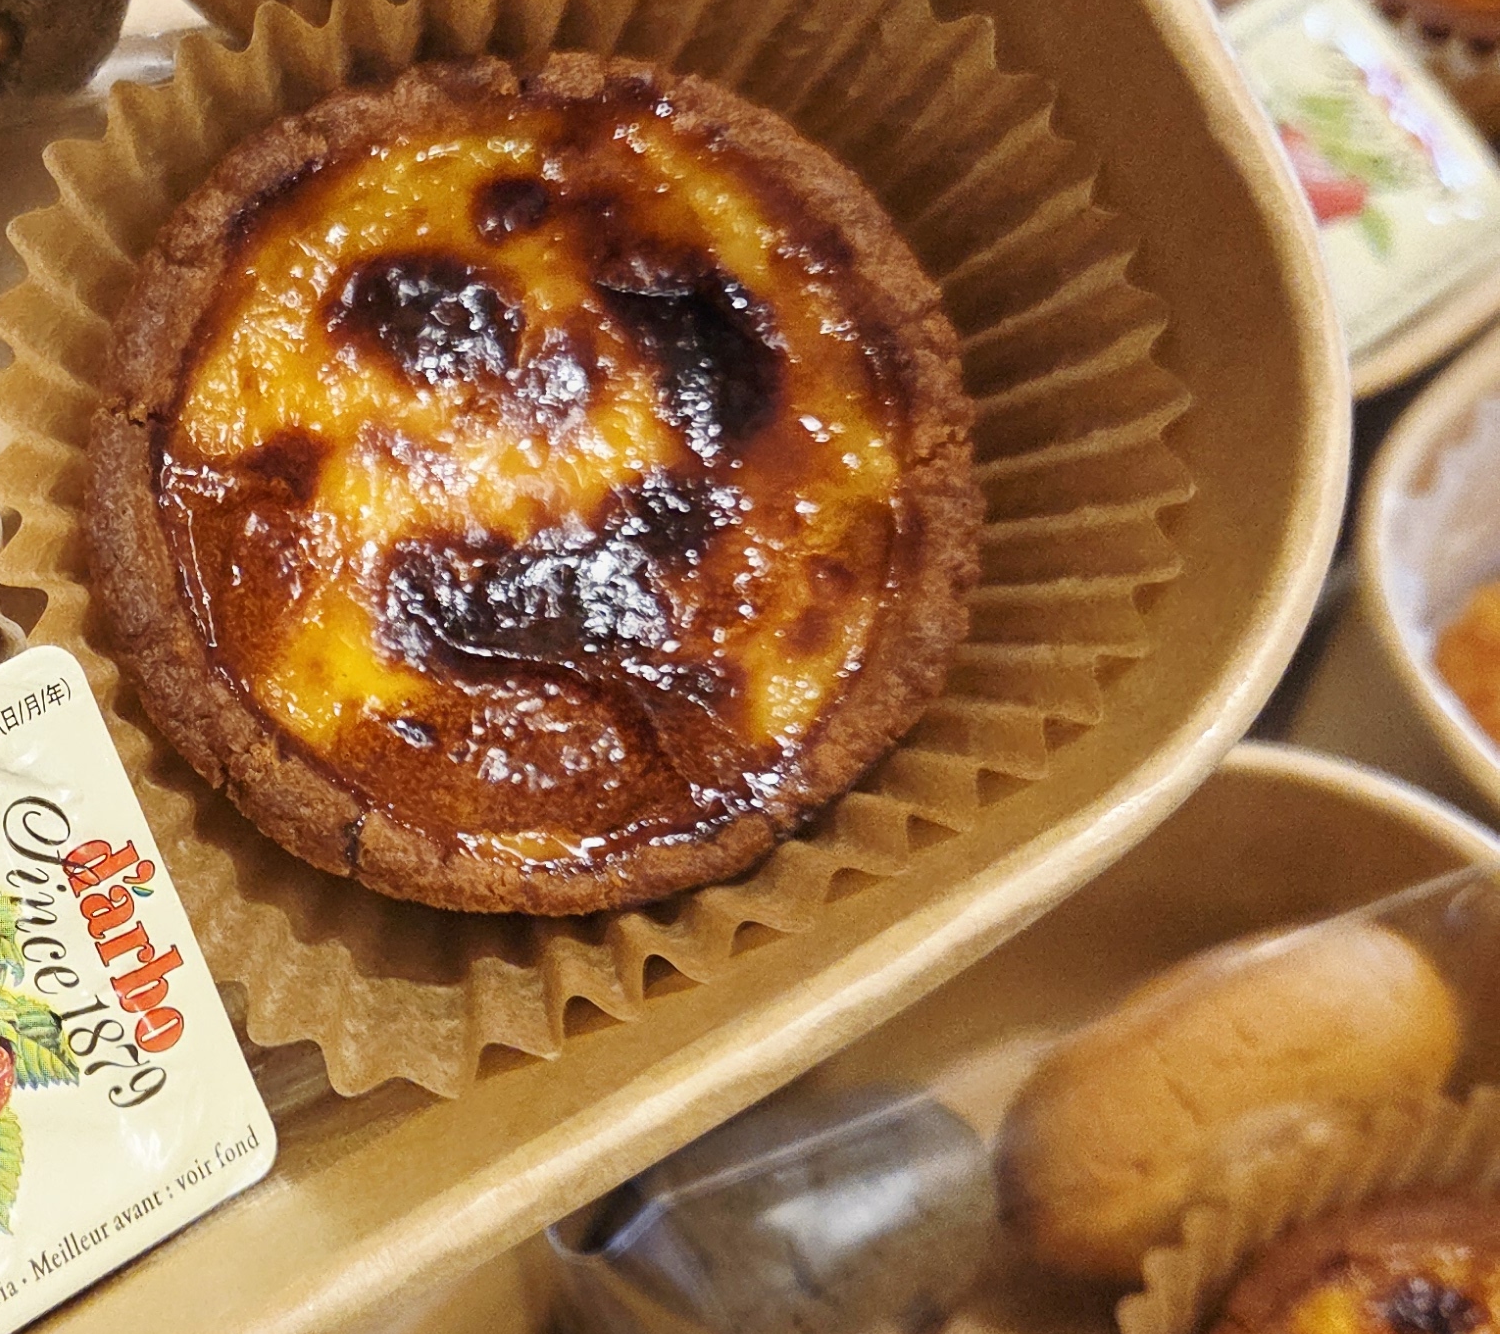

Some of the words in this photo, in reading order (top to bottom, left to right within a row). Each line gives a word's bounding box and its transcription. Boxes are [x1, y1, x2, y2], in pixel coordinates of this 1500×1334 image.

[3, 795, 100, 995] Since
[60, 994, 167, 1108] 1879
[28, 1222, 110, 1282] Meilleur
[175, 1158, 213, 1192] voir
[214, 1124, 261, 1169] fond
